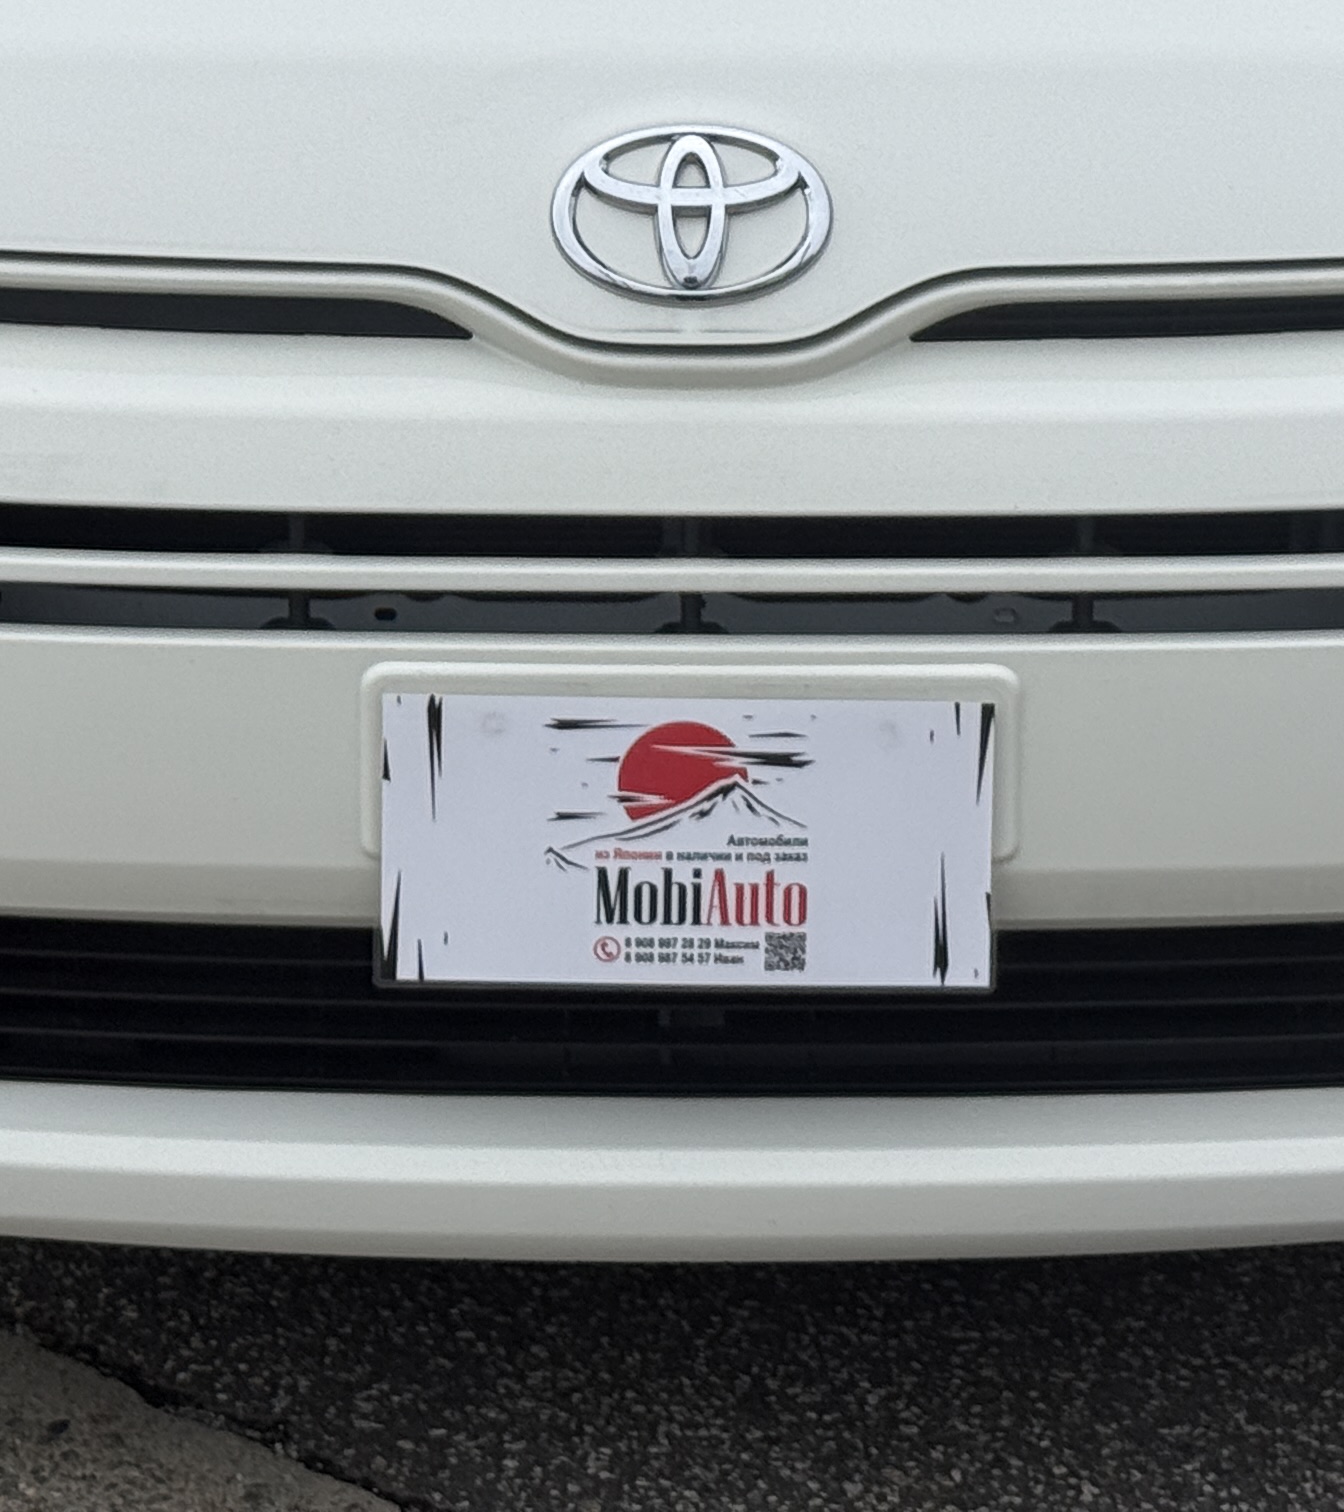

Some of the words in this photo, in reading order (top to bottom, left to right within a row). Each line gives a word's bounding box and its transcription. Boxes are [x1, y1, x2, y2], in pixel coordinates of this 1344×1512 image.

[726, 834, 809, 847] Автомобили
[746, 851, 772, 864] под
[774, 851, 809, 863] заказ
[595, 865, 808, 927] MobiAuto
